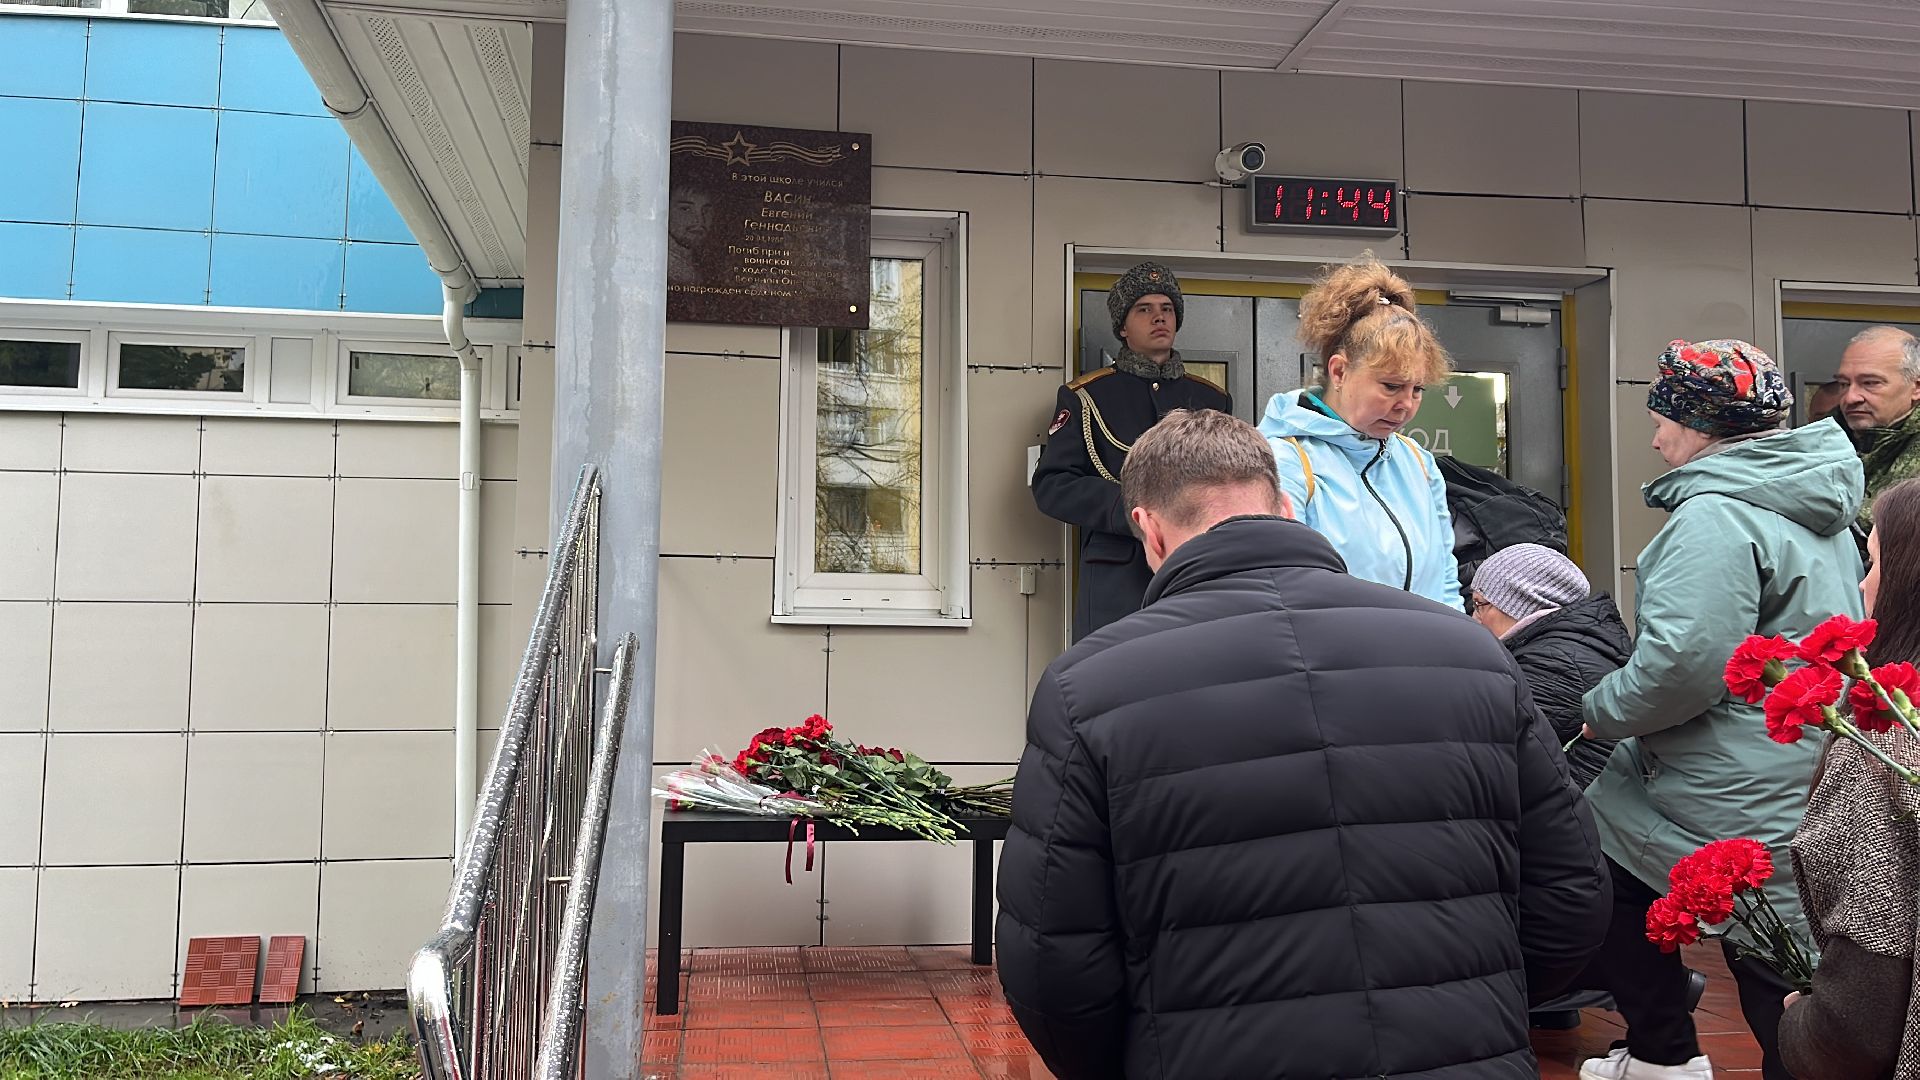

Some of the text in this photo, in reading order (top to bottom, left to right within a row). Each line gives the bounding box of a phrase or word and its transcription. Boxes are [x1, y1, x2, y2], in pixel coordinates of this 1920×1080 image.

[731, 172, 738, 181] В
[740, 174, 767, 183] этой
[769, 176, 804, 186] школе
[763, 190, 812, 205] ВАСИН
[1273, 184, 1392, 222] 11:44
[761, 207, 813, 220] Евгений
[728, 245, 760, 255] Погиб
[761, 248, 781, 257] при
[683, 285, 742, 294] награжден
[1397, 428, 1453, 456] ОД
